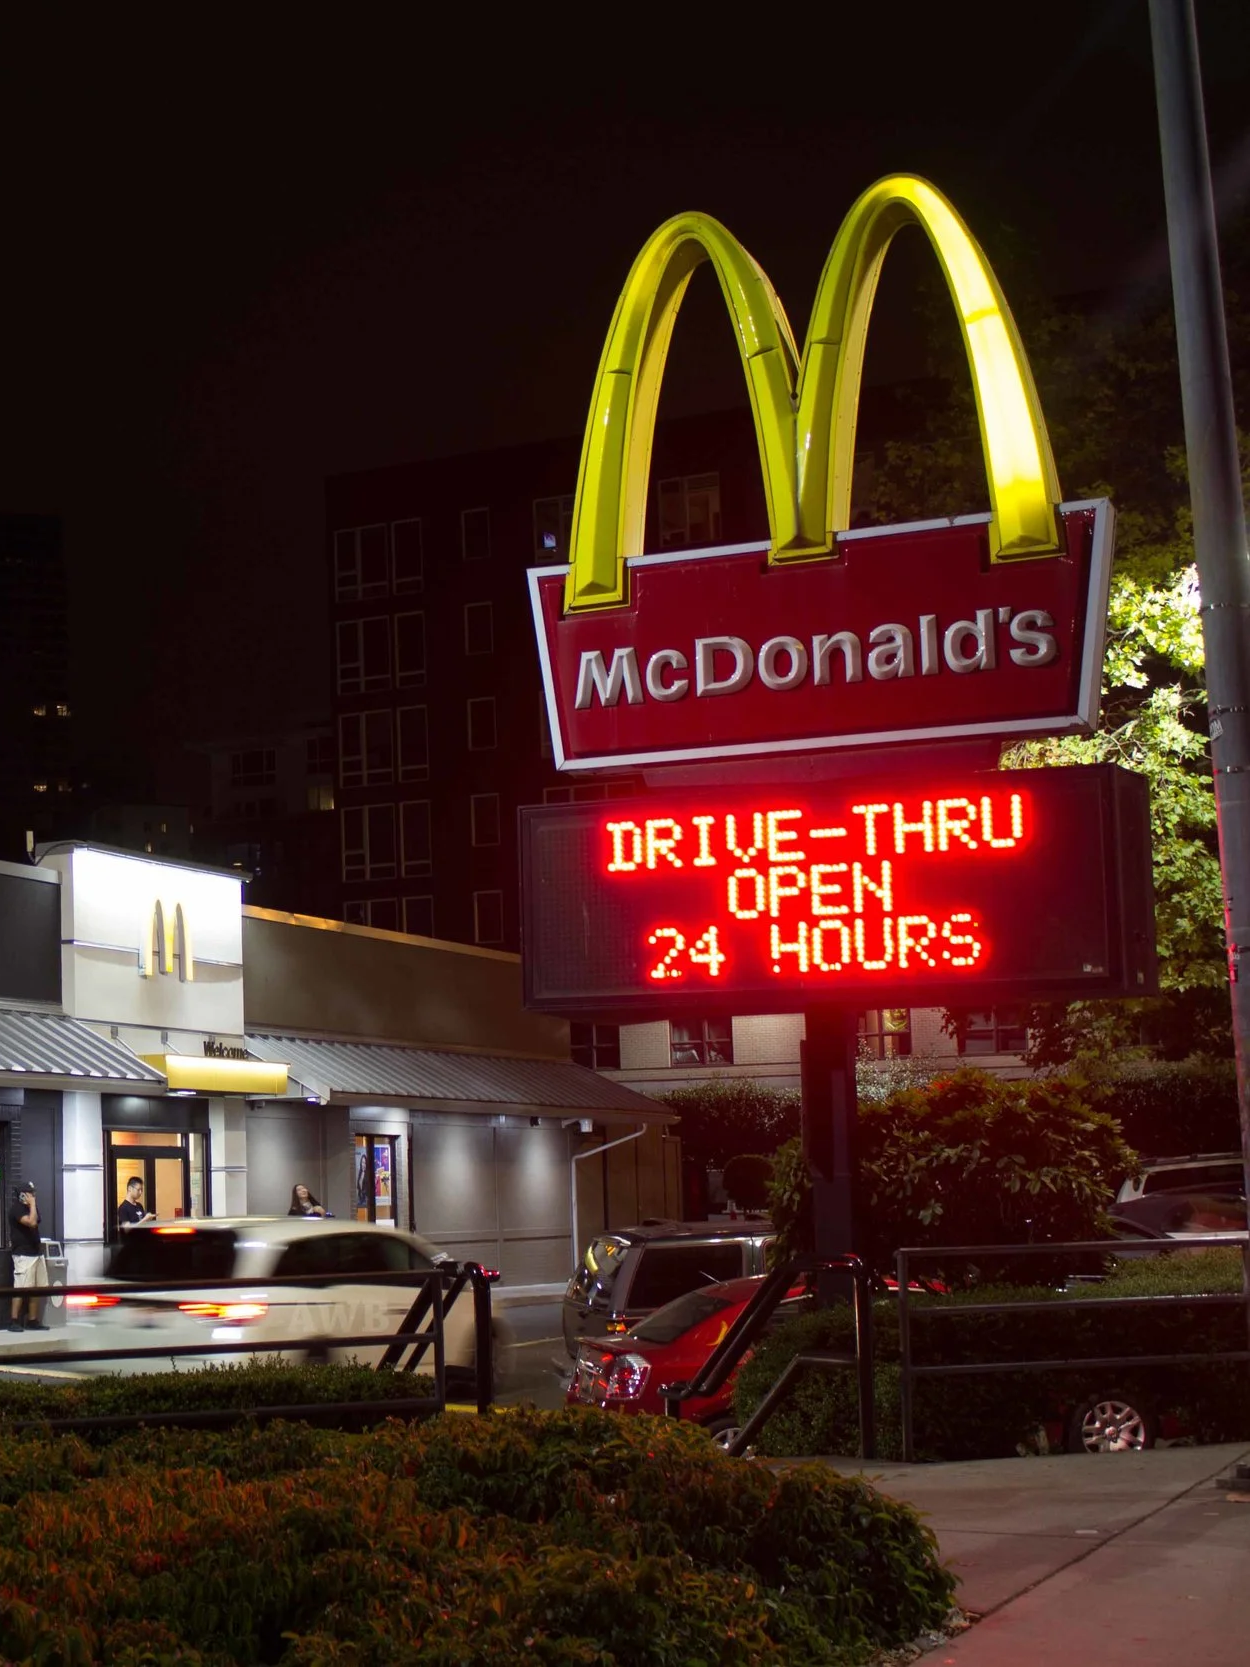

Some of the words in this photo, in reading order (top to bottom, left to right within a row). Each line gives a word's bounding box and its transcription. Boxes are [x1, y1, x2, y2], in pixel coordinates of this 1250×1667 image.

[574, 606, 1057, 710] McDonald's
[605, 794, 1024, 872] DRIVE-THRU
[727, 860, 893, 919] OPEN
[648, 925, 726, 979] 24
[769, 913, 982, 974] HOURS
[203, 1041, 249, 1060] Welcome
